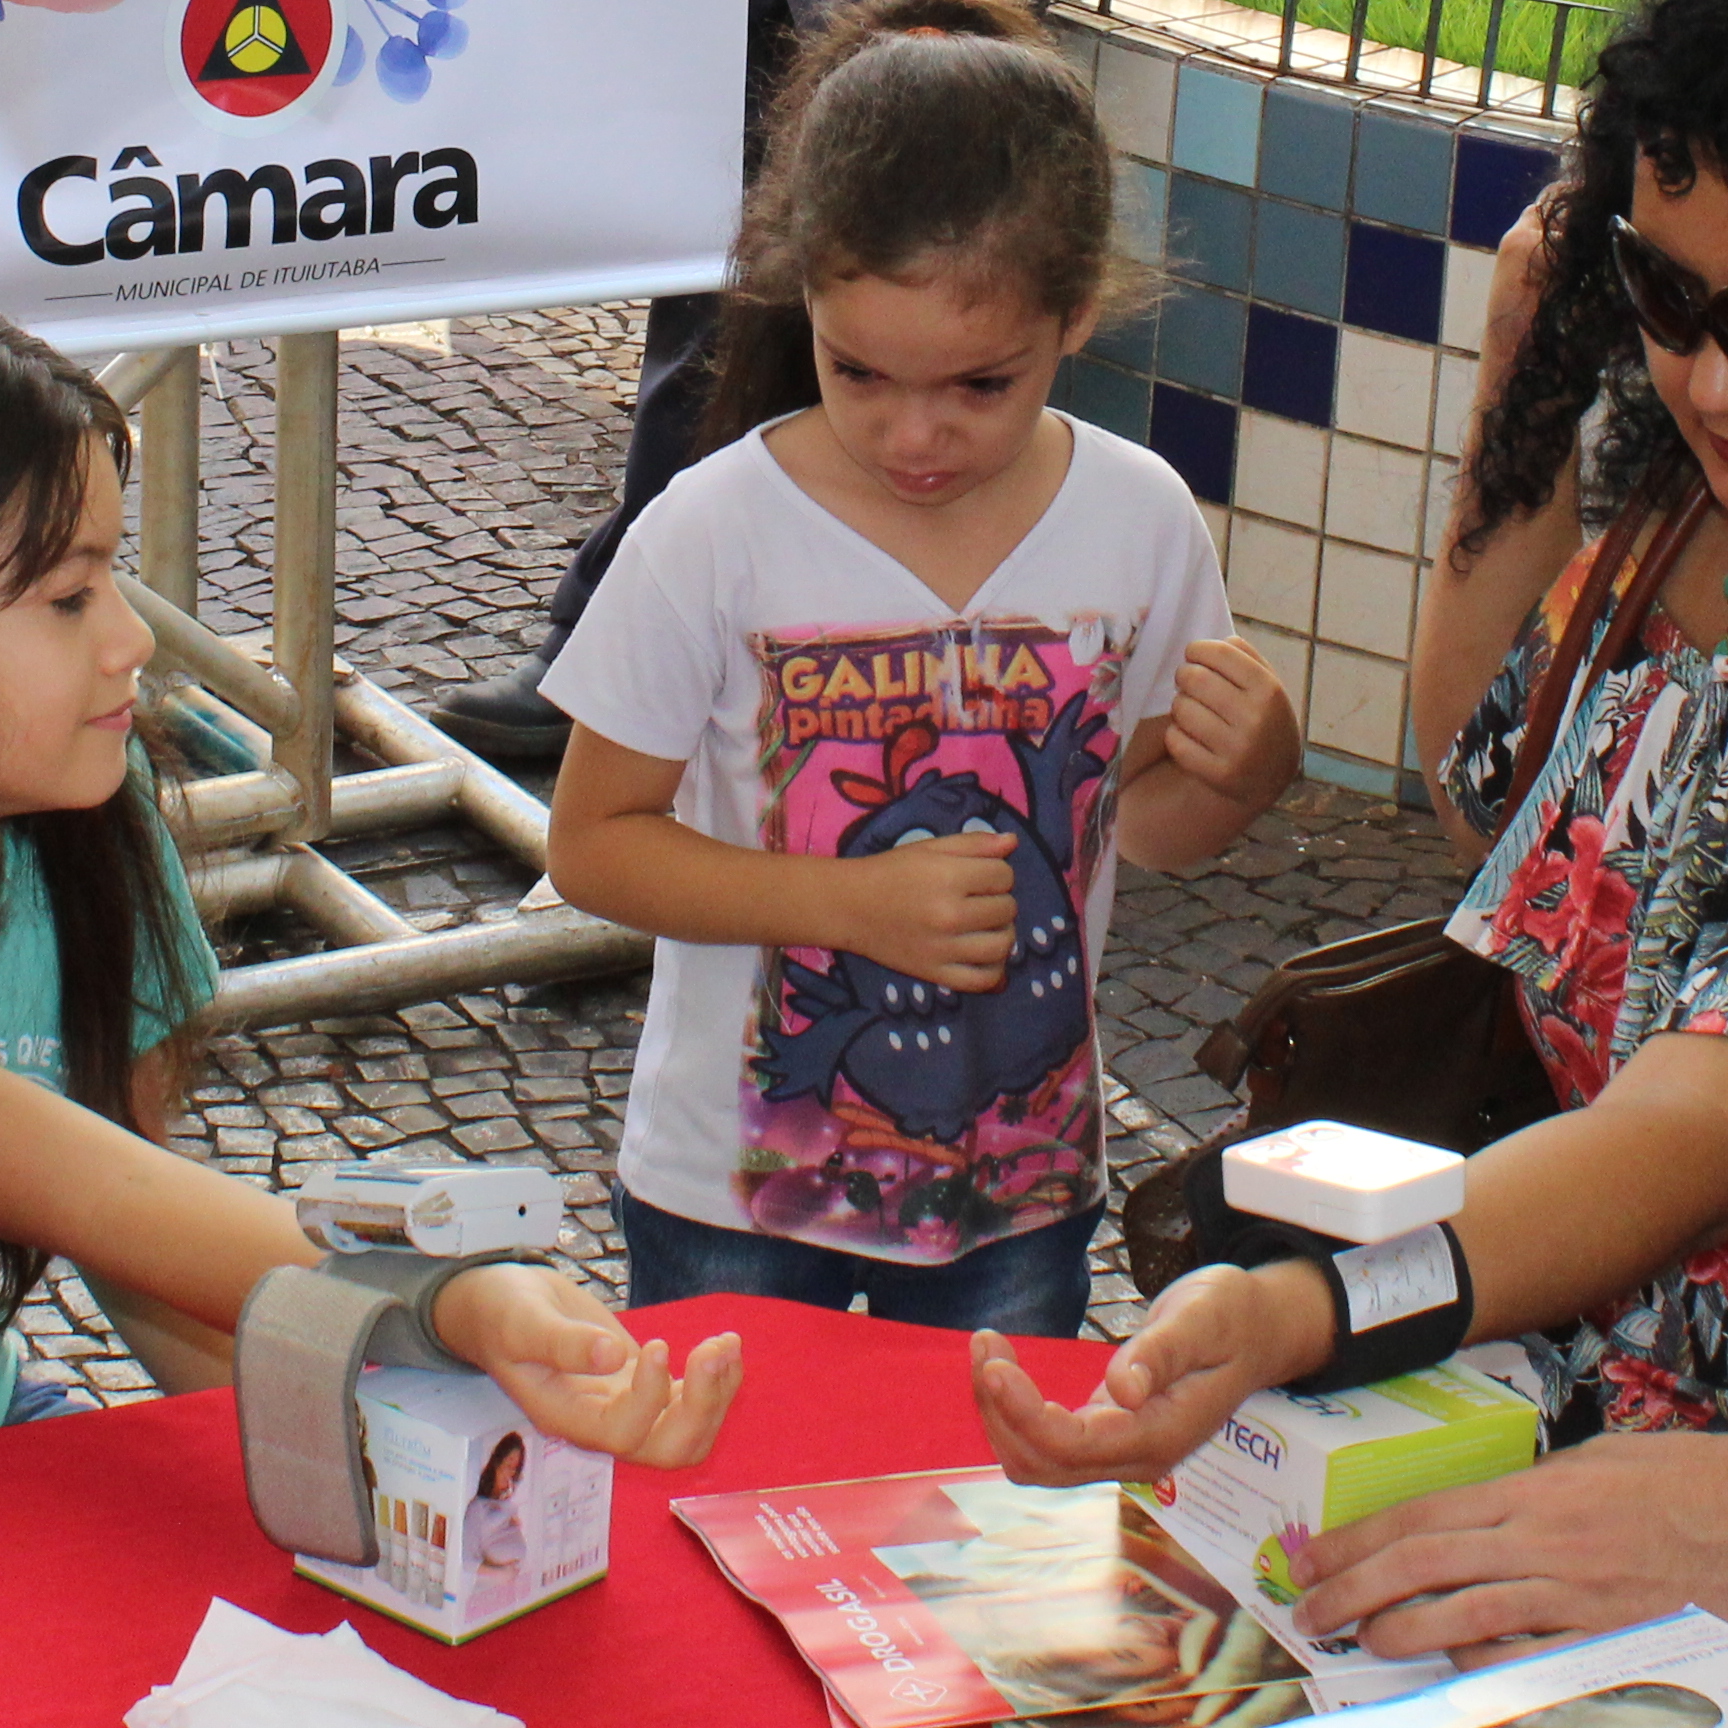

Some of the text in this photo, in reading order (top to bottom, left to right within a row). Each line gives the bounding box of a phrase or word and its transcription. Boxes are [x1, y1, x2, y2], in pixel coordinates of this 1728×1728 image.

[17, 145, 479, 266] Câmara
[115, 257, 380, 302] MUNICIPAL DE ITUIUTABA
[781, 642, 1050, 702] GALINHA
[1224, 1419, 1283, 1471] TECH
[815, 1577, 915, 1672] DROGASIL
